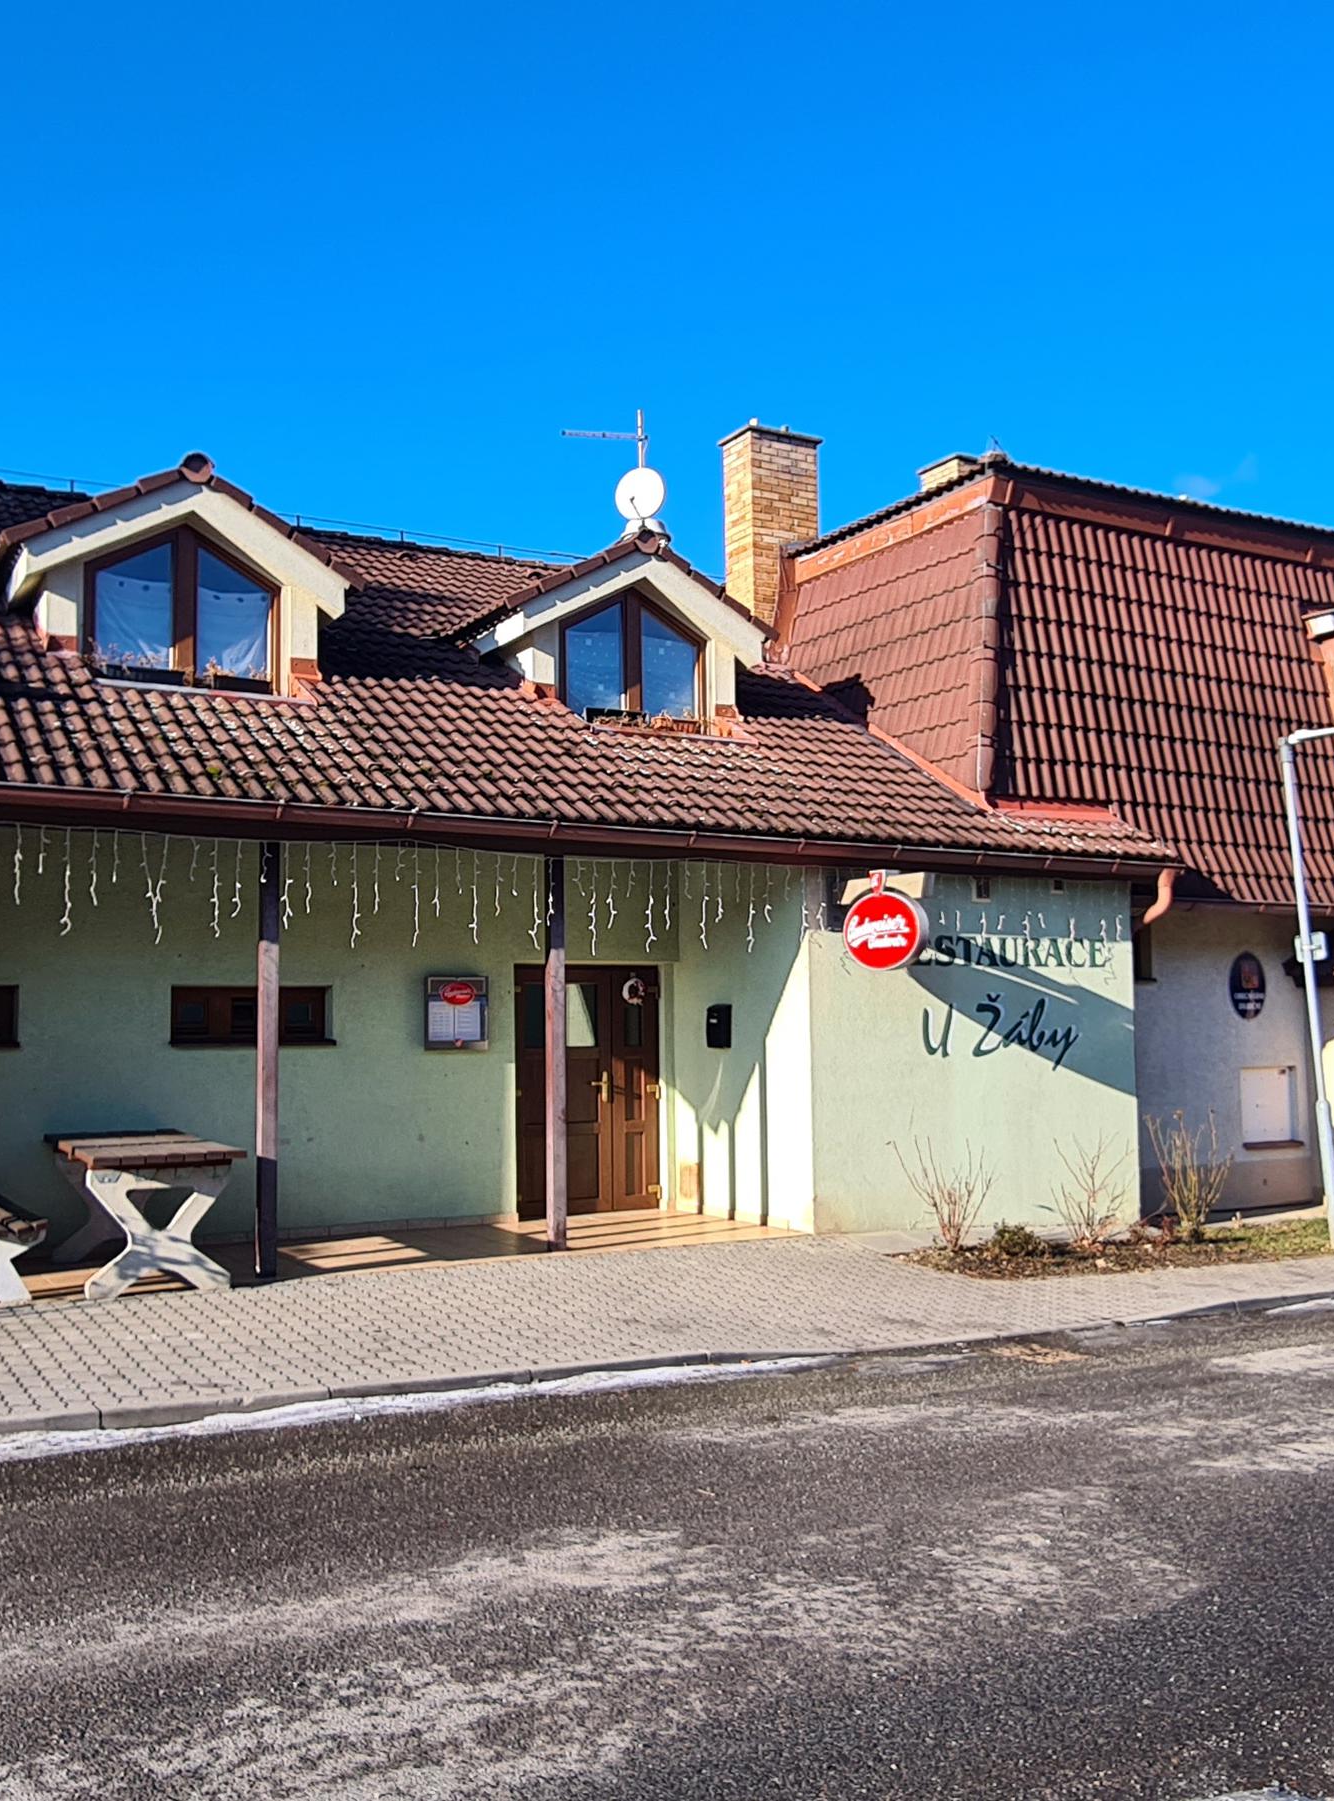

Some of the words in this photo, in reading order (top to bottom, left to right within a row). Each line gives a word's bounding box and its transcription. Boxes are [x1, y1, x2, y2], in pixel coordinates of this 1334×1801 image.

[912, 935, 1107, 968] ESTAURACE
[922, 1003, 954, 1058] U
[972, 993, 1079, 1071] Žáby
